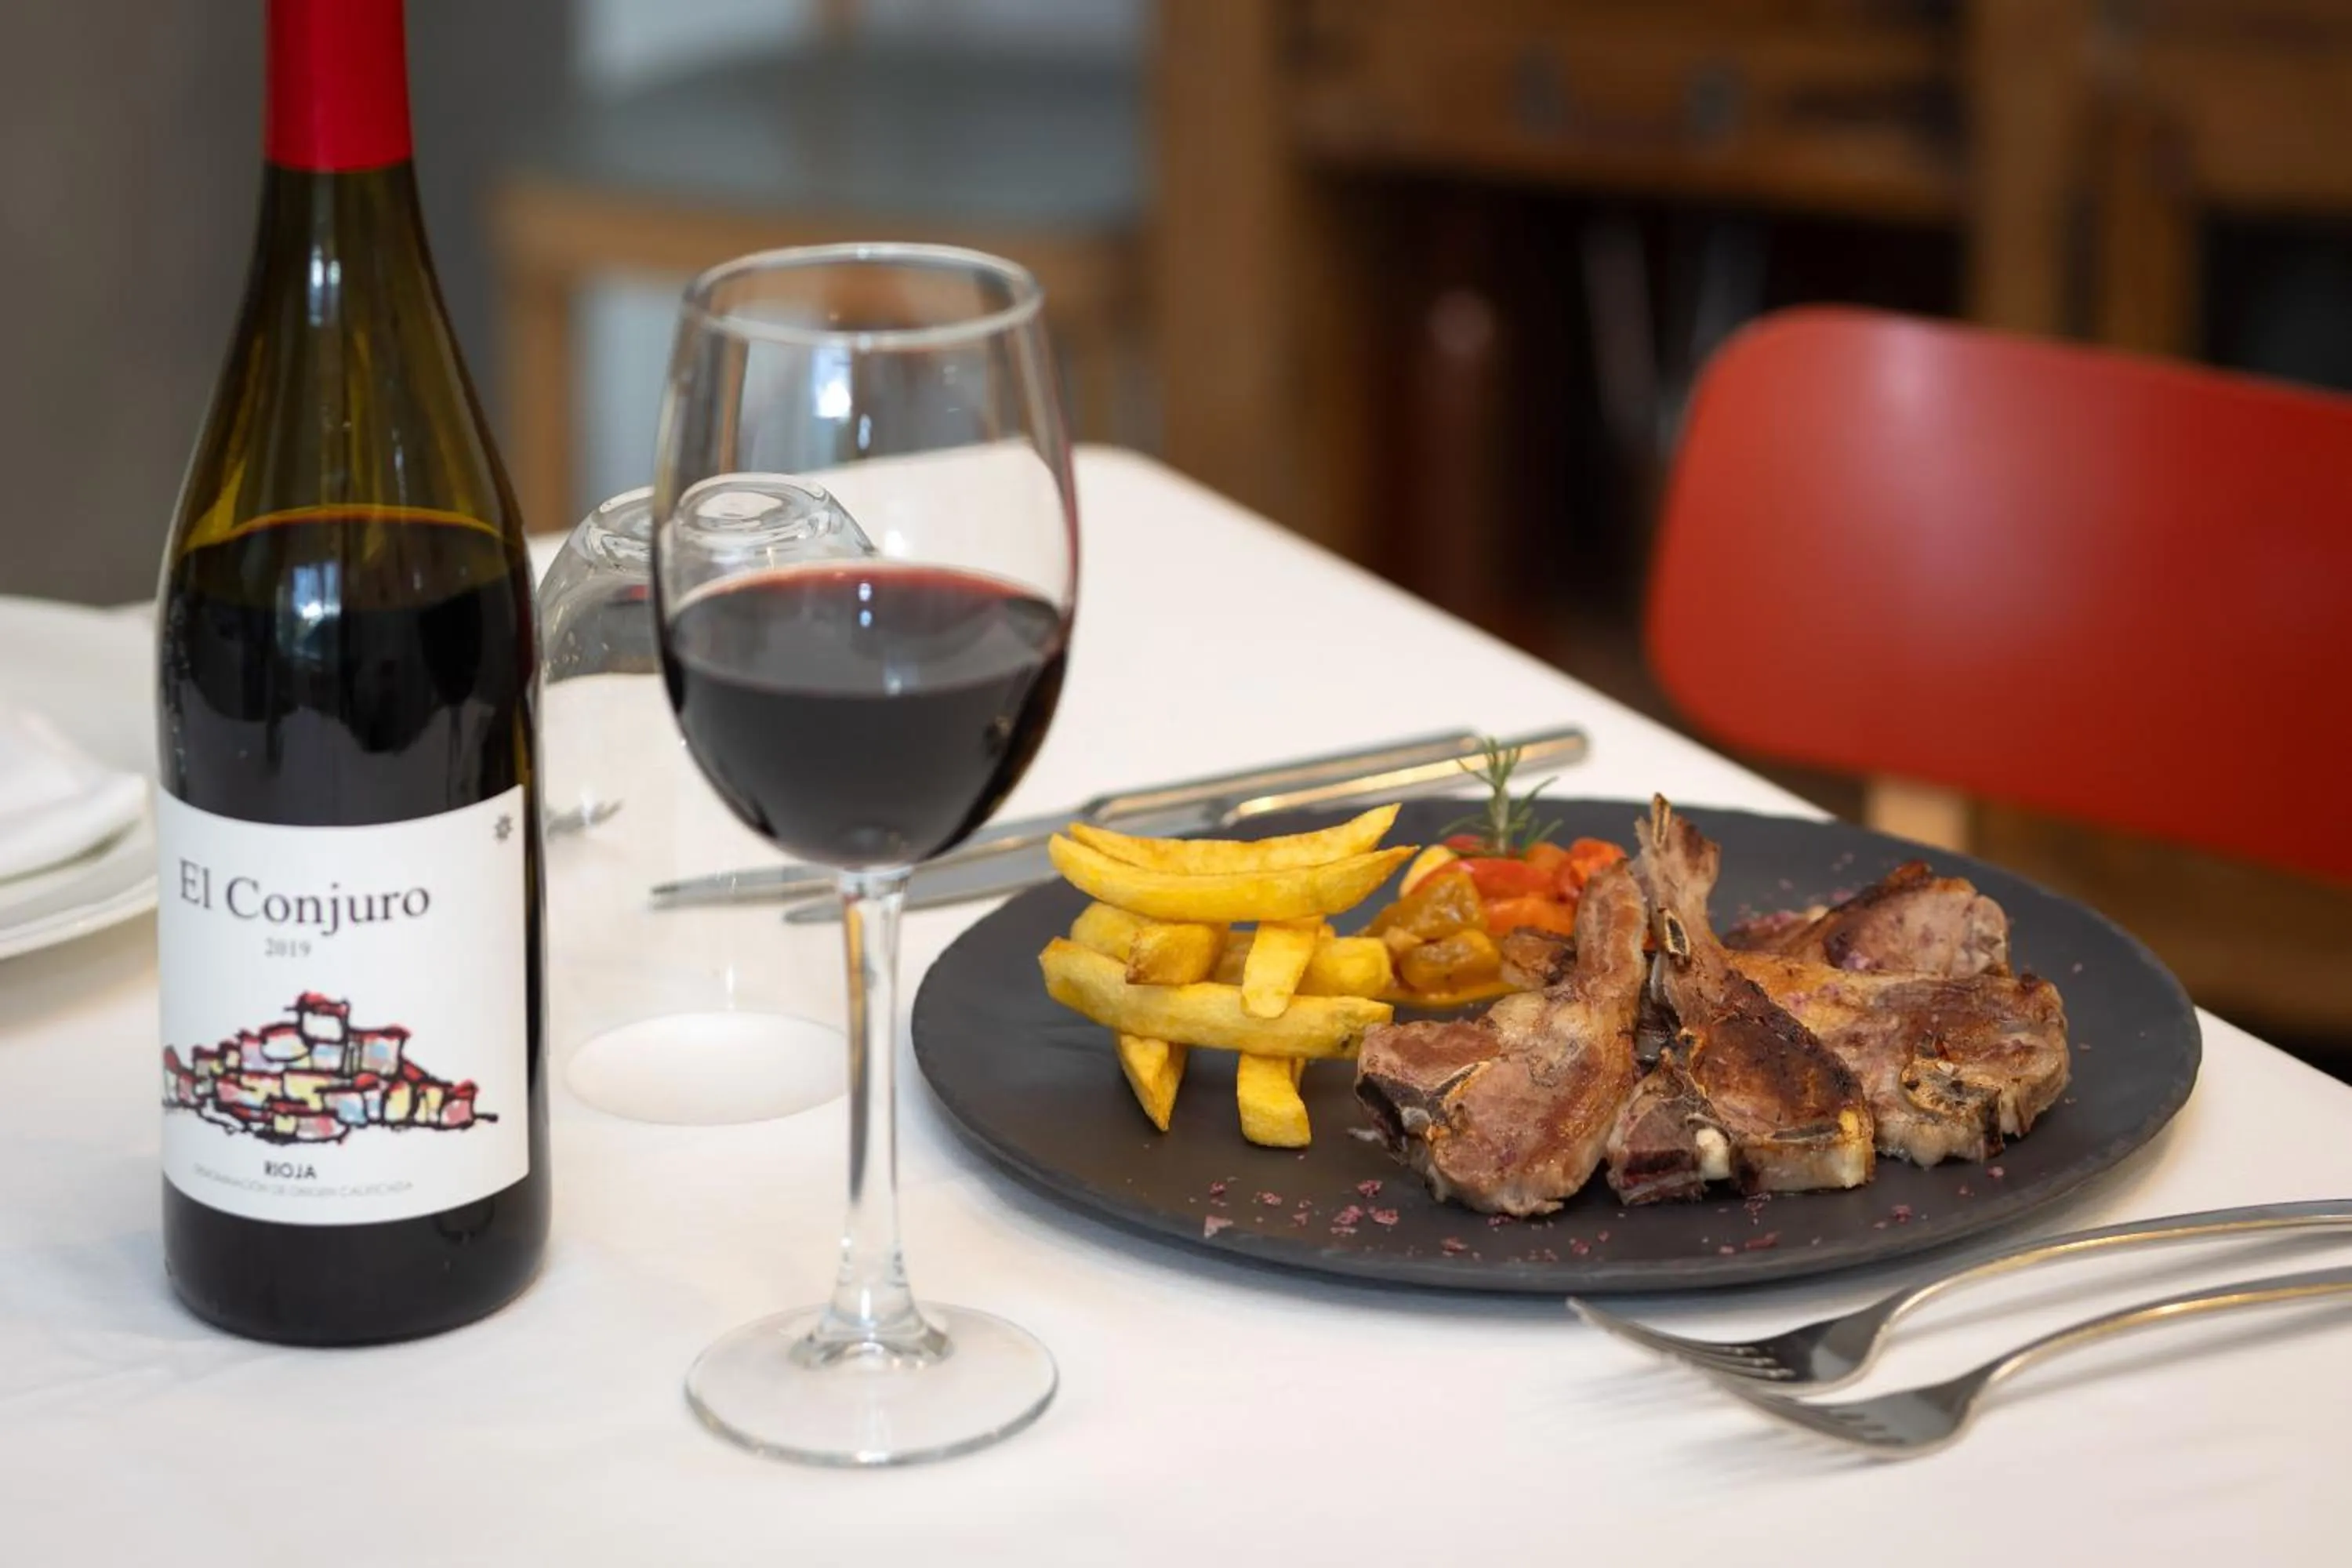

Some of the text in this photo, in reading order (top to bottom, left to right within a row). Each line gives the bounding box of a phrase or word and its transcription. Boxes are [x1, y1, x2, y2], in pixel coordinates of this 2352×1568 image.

[180, 858, 430, 936] El Conjuro
[264, 936, 312, 957] 2019
[263, 1160, 318, 1179] RIOJA
